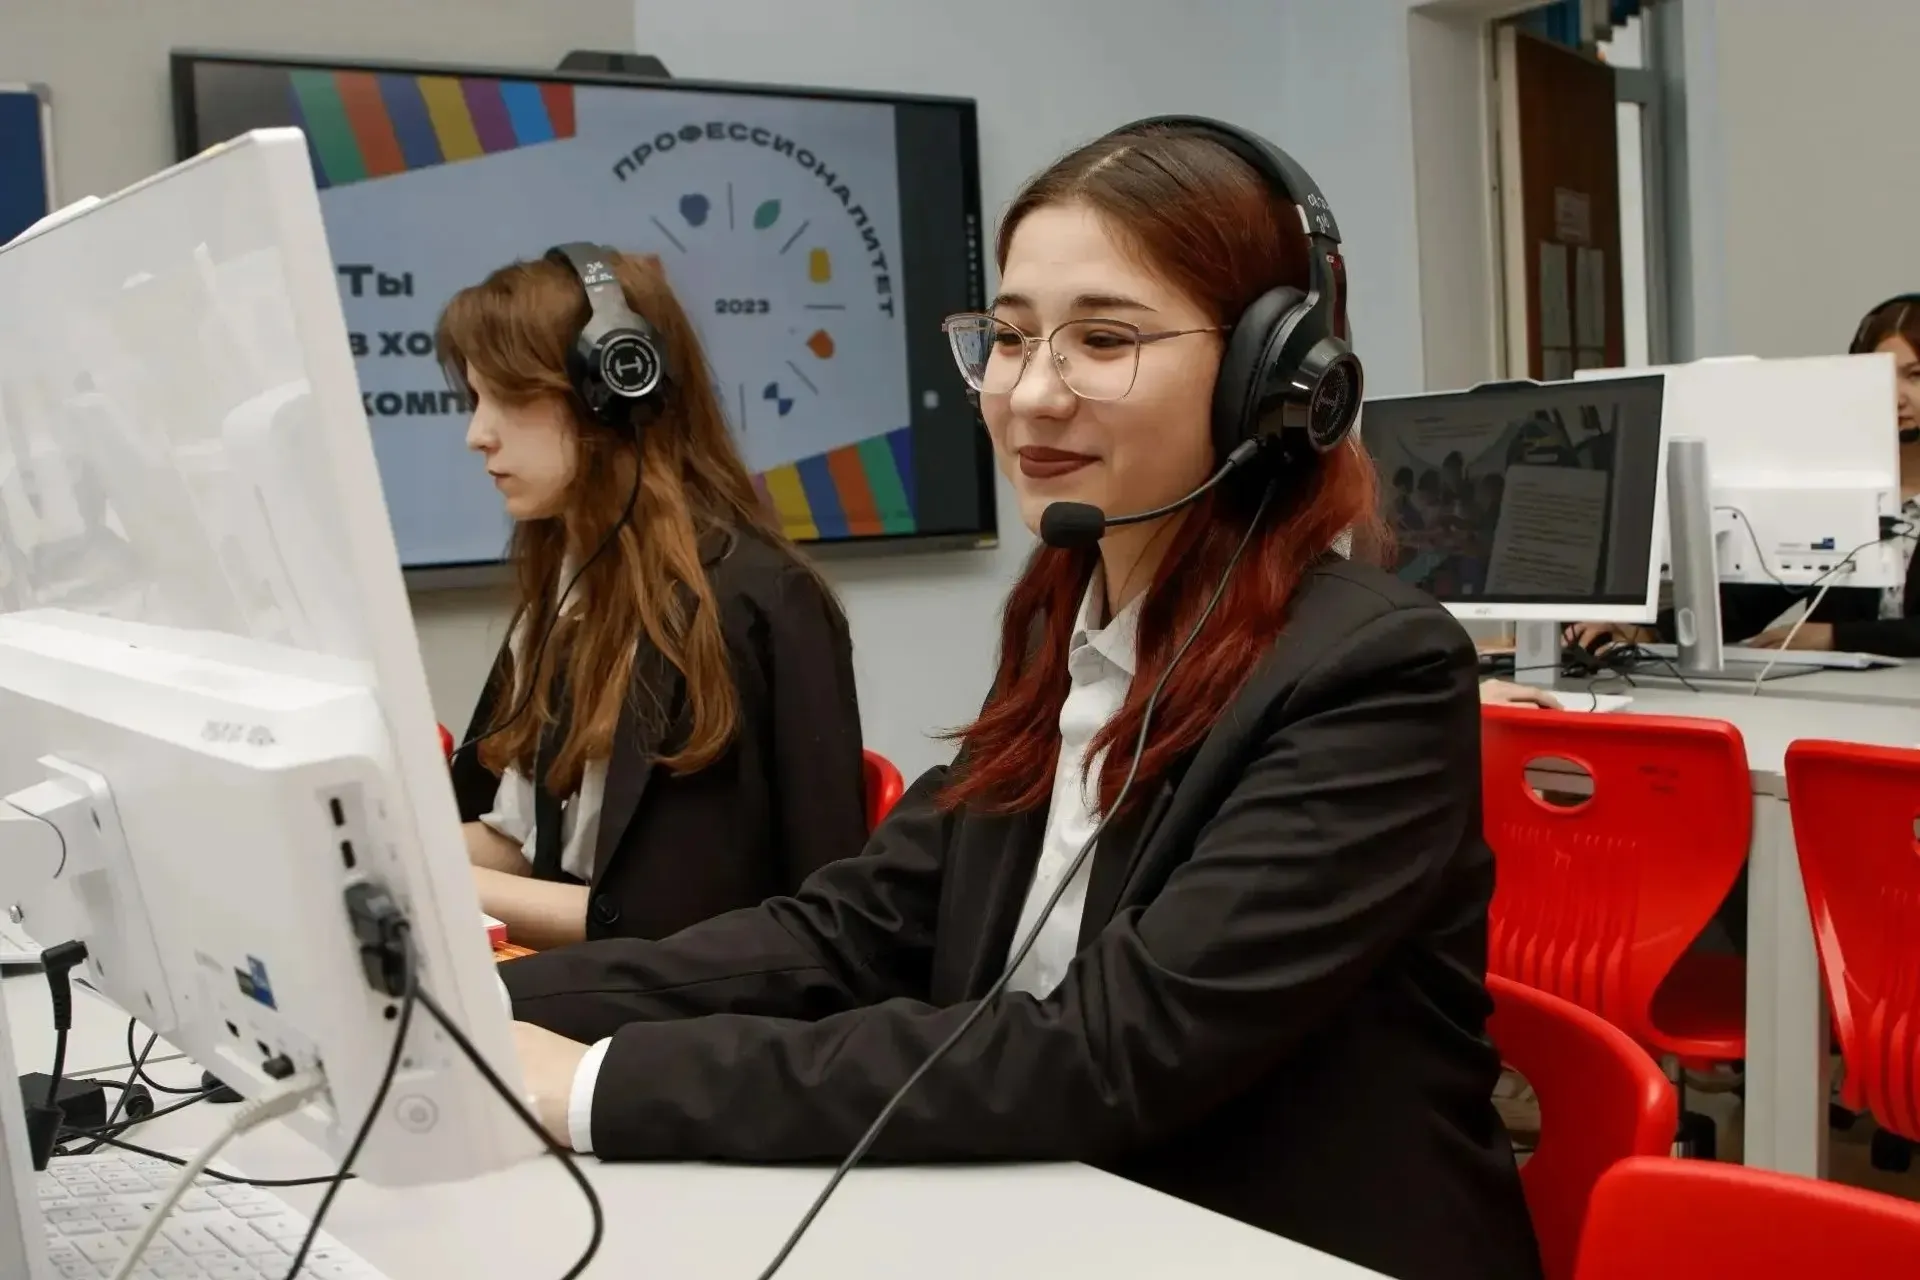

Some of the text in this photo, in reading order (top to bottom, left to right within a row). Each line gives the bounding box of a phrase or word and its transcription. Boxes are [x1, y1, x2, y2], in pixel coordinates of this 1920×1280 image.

[611, 121, 894, 318] ПРОФЕССИОНАЛИТЕТ
[337, 264, 414, 298] Ты
[714, 297, 770, 315] 2023
[377, 331, 434, 357] хо
